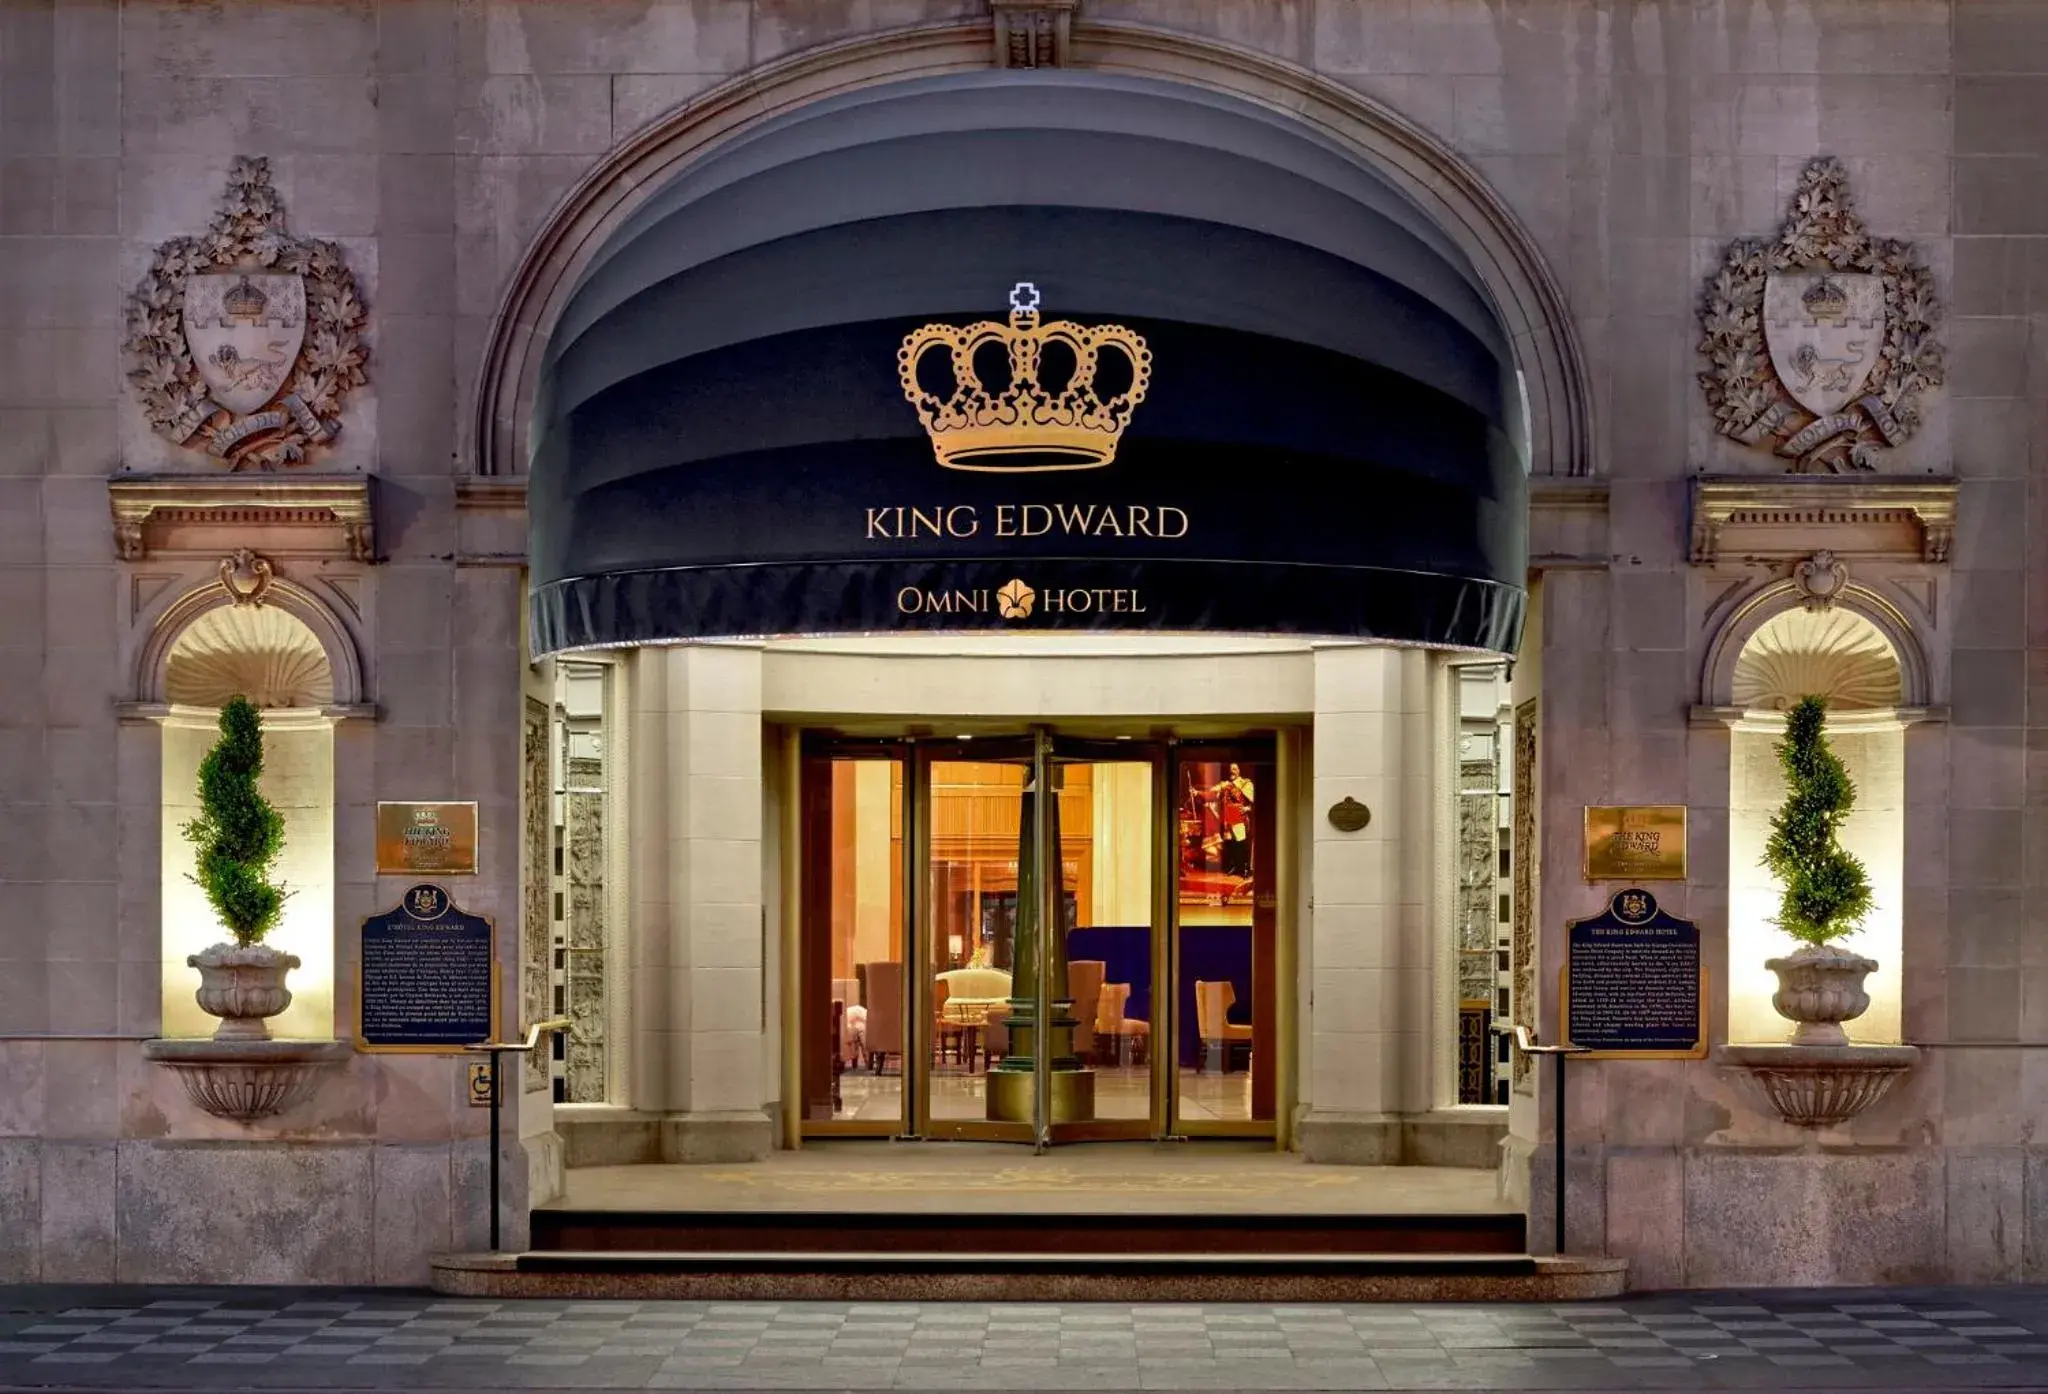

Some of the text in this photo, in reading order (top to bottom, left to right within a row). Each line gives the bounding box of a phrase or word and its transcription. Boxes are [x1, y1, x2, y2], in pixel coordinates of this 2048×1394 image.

[865, 503, 1189, 539] KING EDWARD
[897, 586, 1146, 614] OMNI HOTEL
